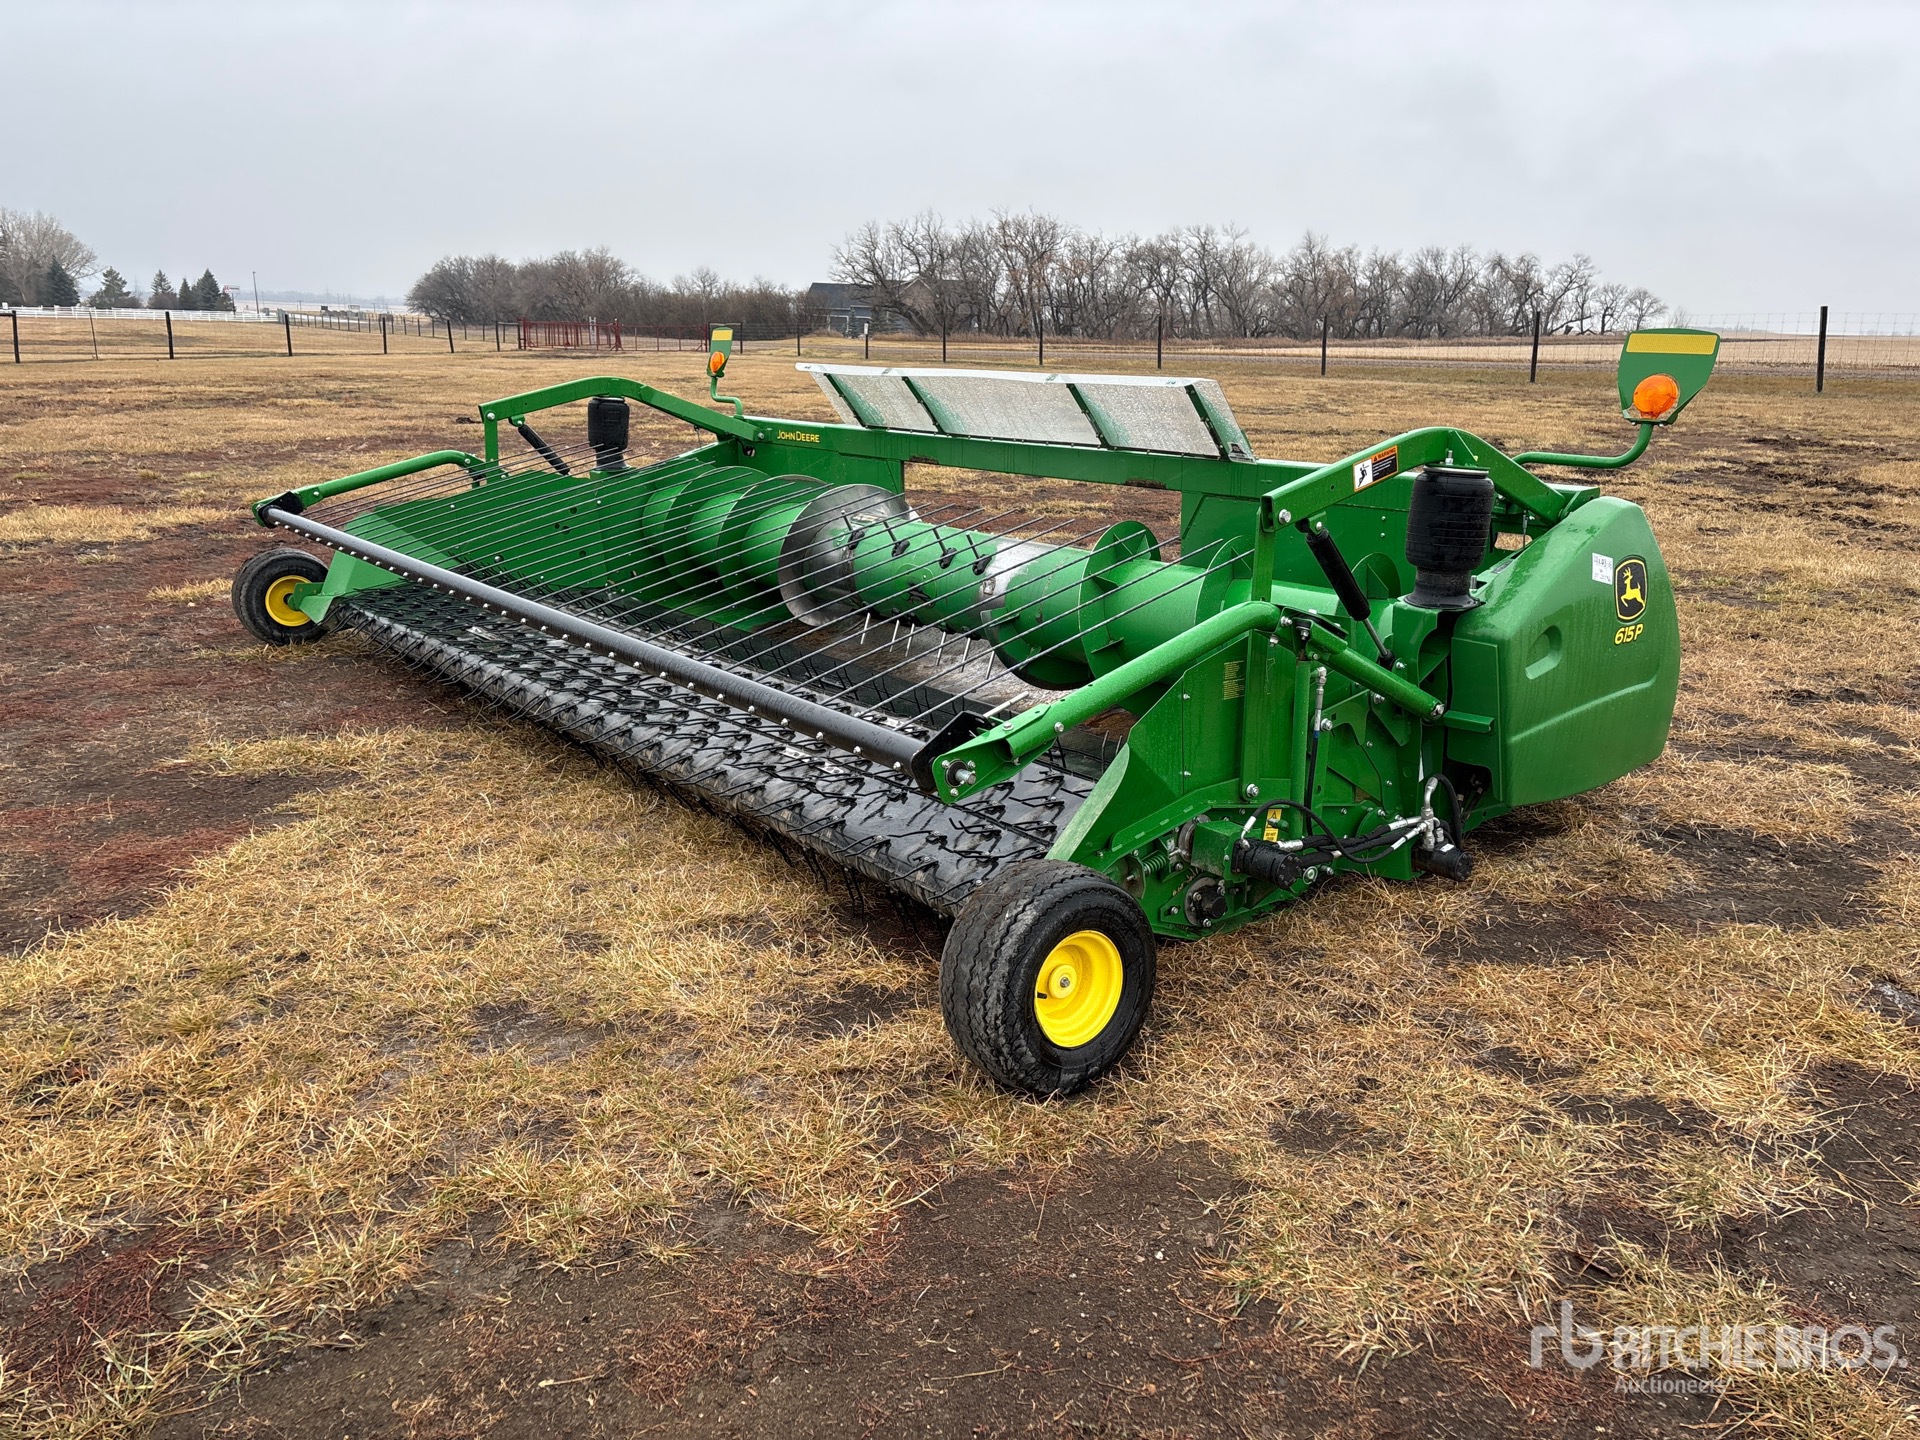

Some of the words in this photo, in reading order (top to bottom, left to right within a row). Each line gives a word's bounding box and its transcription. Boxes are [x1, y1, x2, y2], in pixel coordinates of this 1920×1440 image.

[777, 429, 796, 440] JOHN
[796, 430, 820, 443] DEERE
[1377, 447, 1396, 459] WARNING
[1614, 624, 1644, 645] 615P
